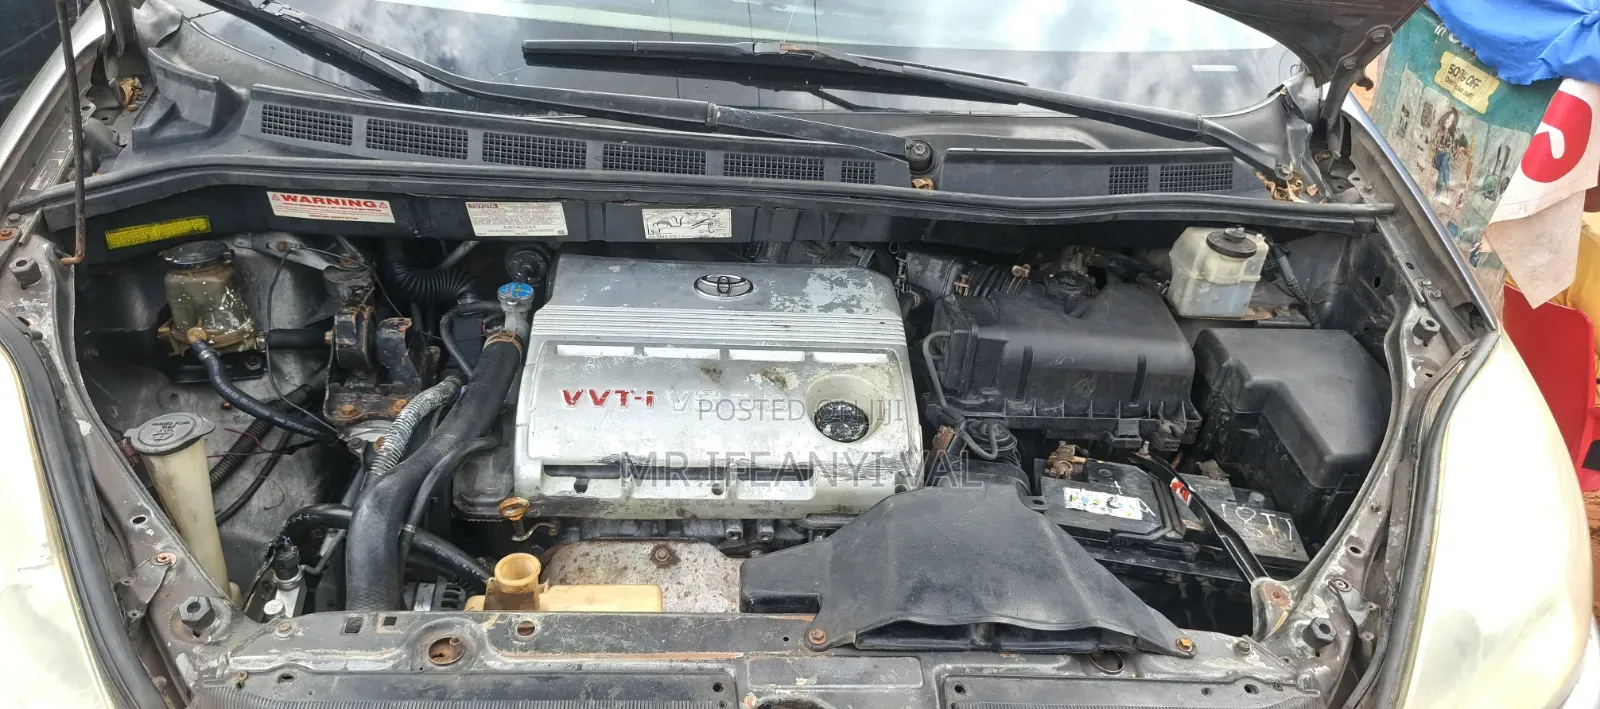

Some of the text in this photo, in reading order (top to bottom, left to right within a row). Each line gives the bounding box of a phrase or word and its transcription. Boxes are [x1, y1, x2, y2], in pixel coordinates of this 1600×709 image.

[1448, 63, 1483, 90] 50% OFF
[281, 194, 378, 208] WARNING
[560, 388, 655, 411] VVT-i
